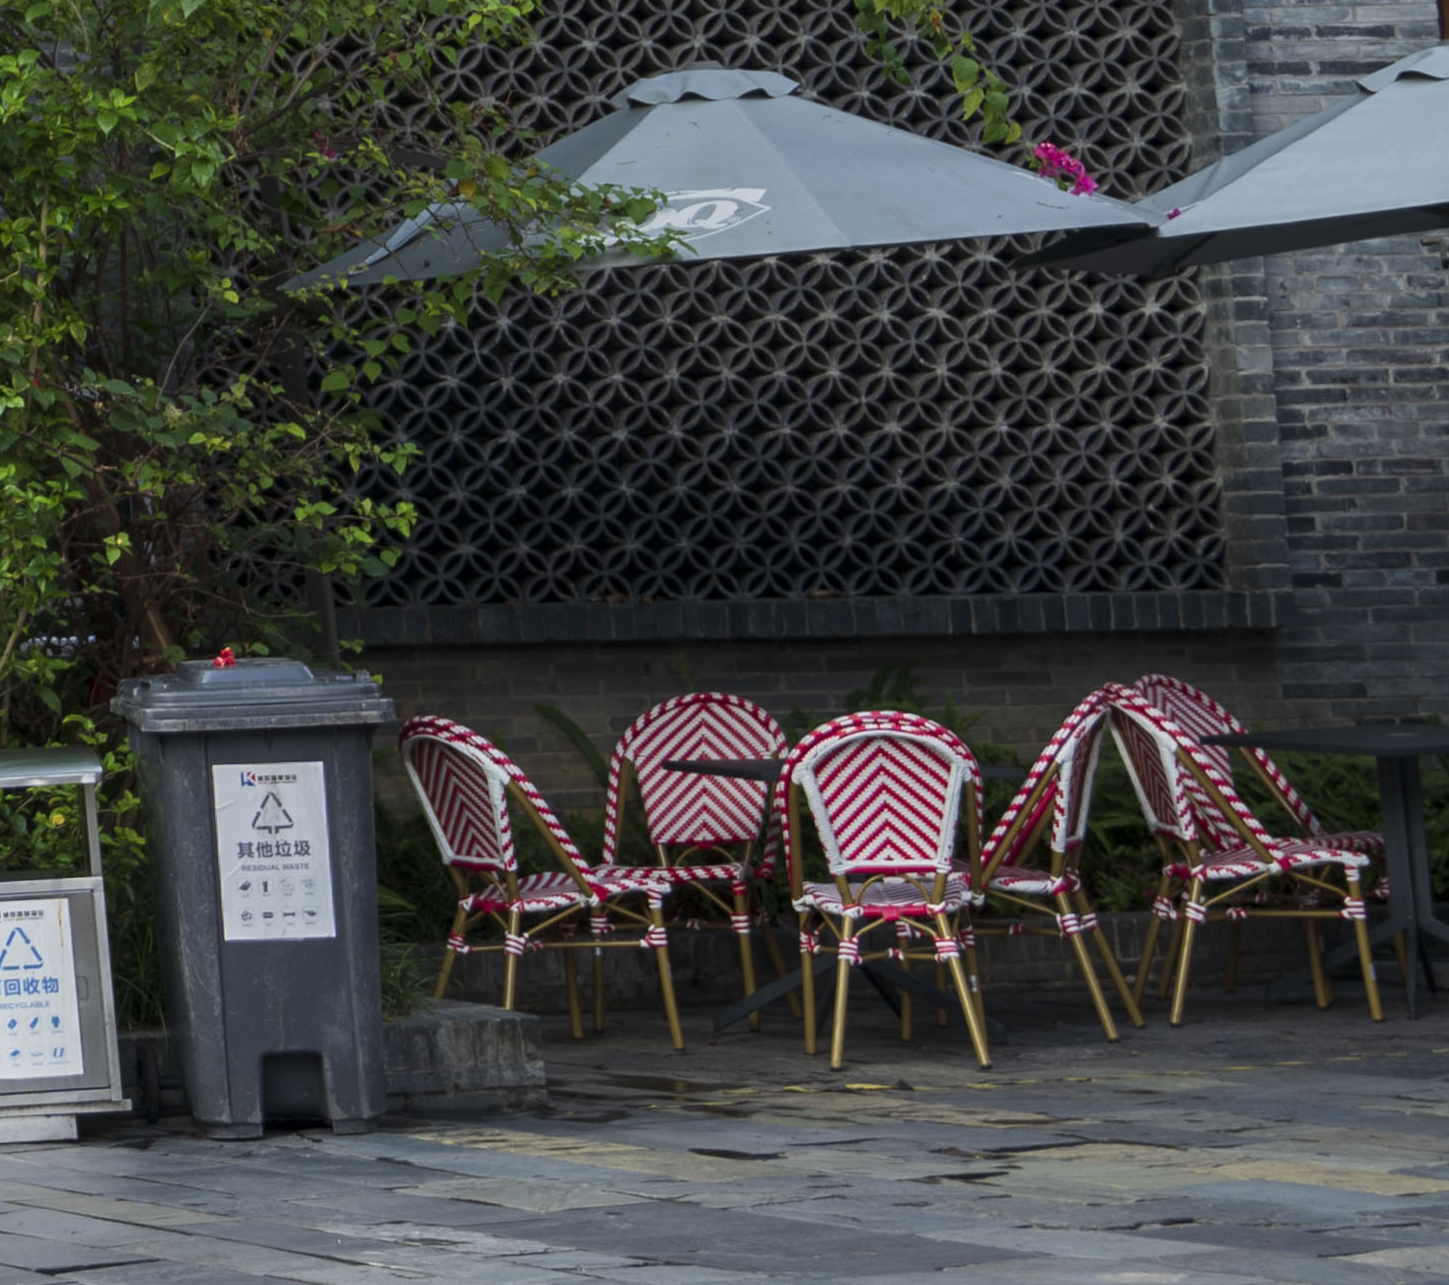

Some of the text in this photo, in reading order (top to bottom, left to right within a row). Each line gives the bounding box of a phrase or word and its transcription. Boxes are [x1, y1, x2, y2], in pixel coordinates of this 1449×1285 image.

[237, 839, 311, 859] 其他垃圾
[241, 861, 310, 872] RESIDUAL WASTE
